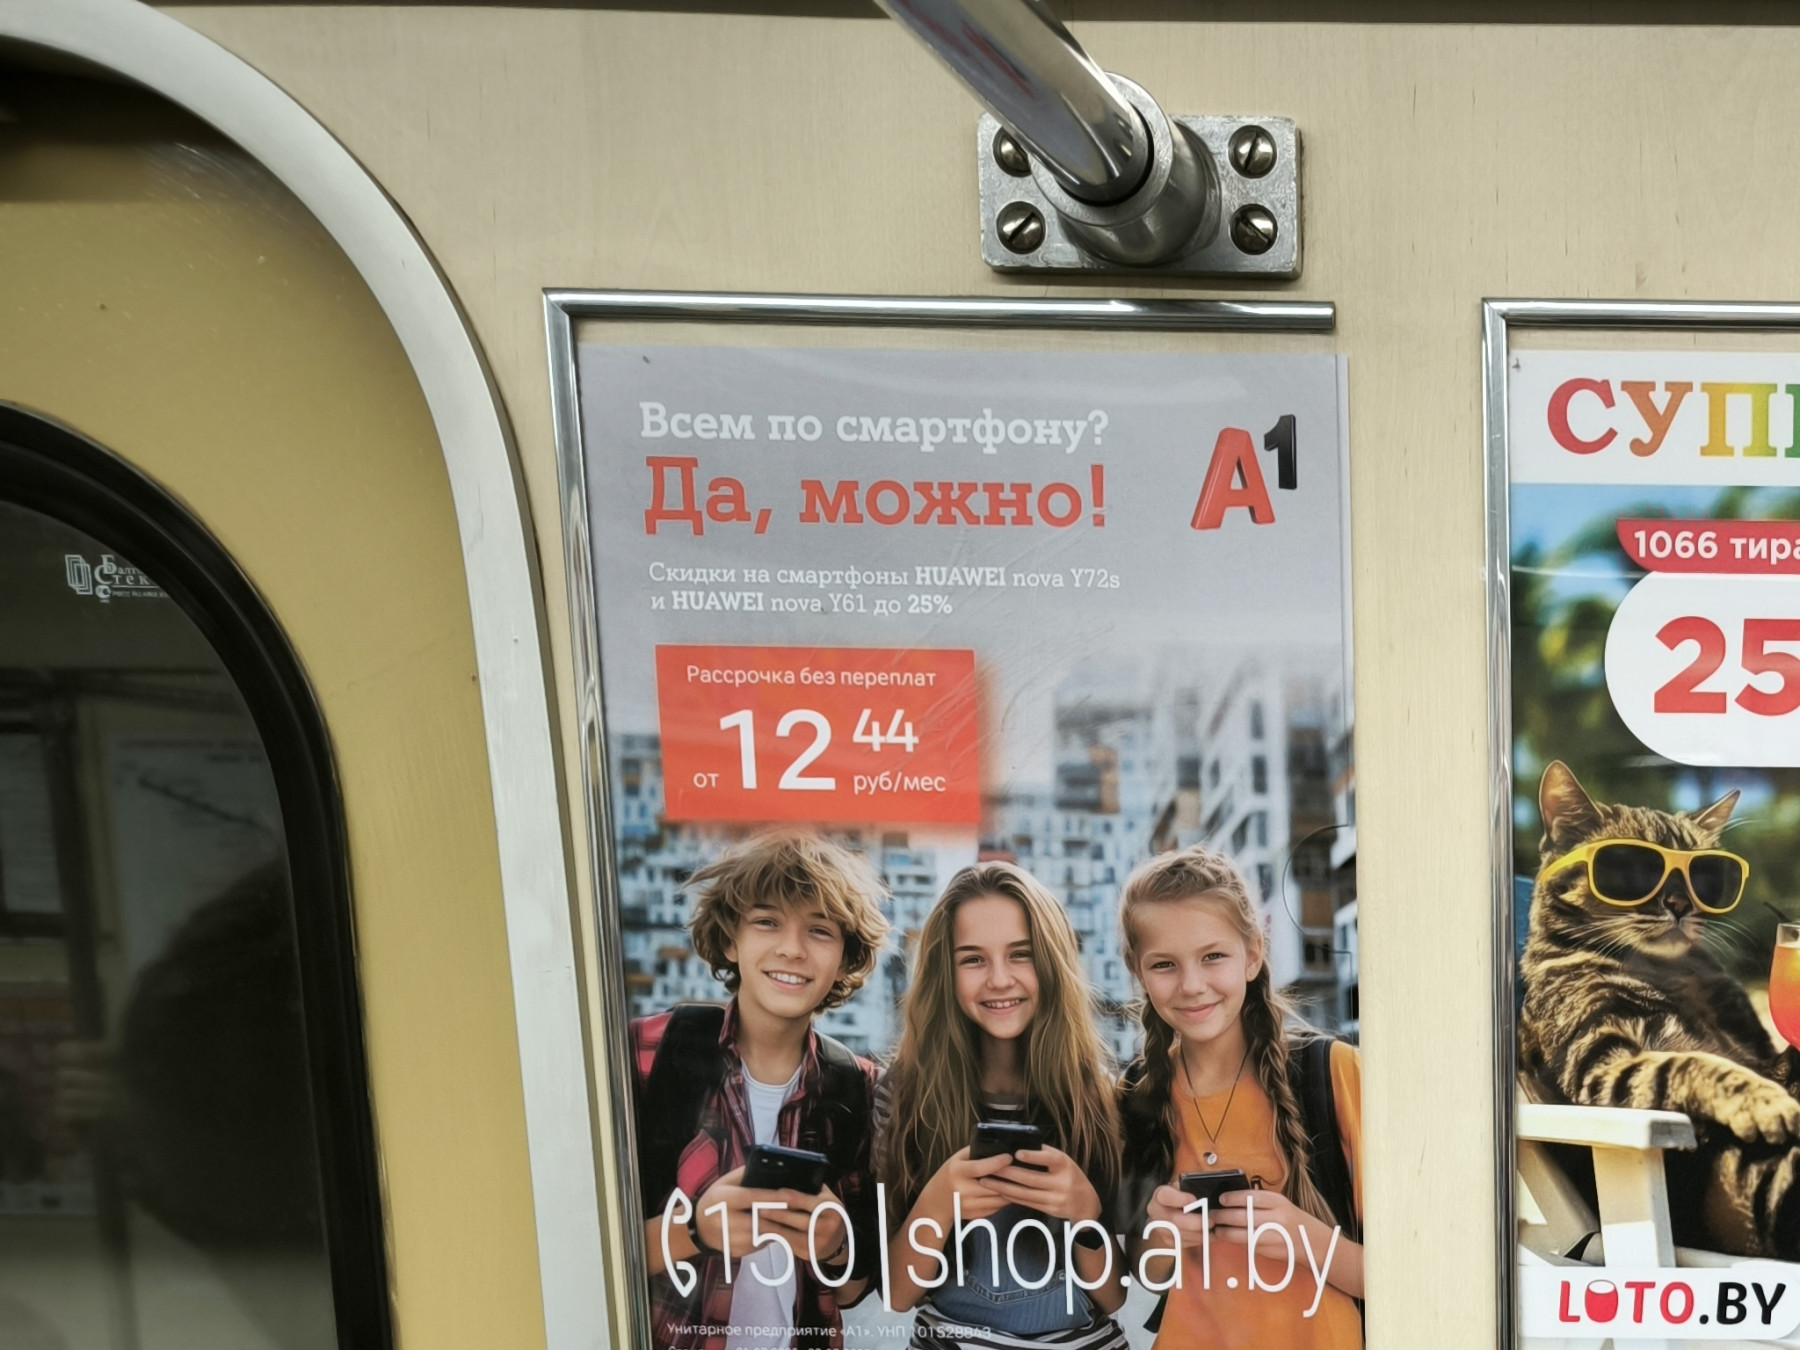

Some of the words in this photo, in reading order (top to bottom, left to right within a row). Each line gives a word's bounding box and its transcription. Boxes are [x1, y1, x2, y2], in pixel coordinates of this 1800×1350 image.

[639, 401, 756, 441] Всем
[768, 414, 823, 441] по
[837, 404, 1108, 457] смартфону?
[644, 456, 771, 536] Да,
[799, 464, 1105, 531] можно!
[1634, 530, 1718, 558] 1066
[649, 561, 736, 585] Скидки
[743, 569, 770, 585] на
[776, 563, 909, 590] смартфоны
[915, 565, 1007, 587] HUAWEI
[1013, 573, 1064, 588] nova
[1070, 568, 1120, 588] Y72s
[652, 596, 665, 610] и
[672, 590, 764, 611] HUAWEI
[771, 596, 823, 611] nova
[829, 593, 867, 613] Y61
[874, 599, 900, 617] до
[908, 594, 952, 613] 25%
[687, 665, 795, 689] Рассрочка
[799, 667, 835, 686] без
[840, 670, 936, 691] переплат
[718, 708, 836, 790] 12
[852, 708, 920, 754] 44
[692, 770, 719, 789] от
[852, 768, 946, 796] руб/мес
[703, 1199, 856, 1287] 150
[906, 1190, 1341, 1318] shop.a1.by
